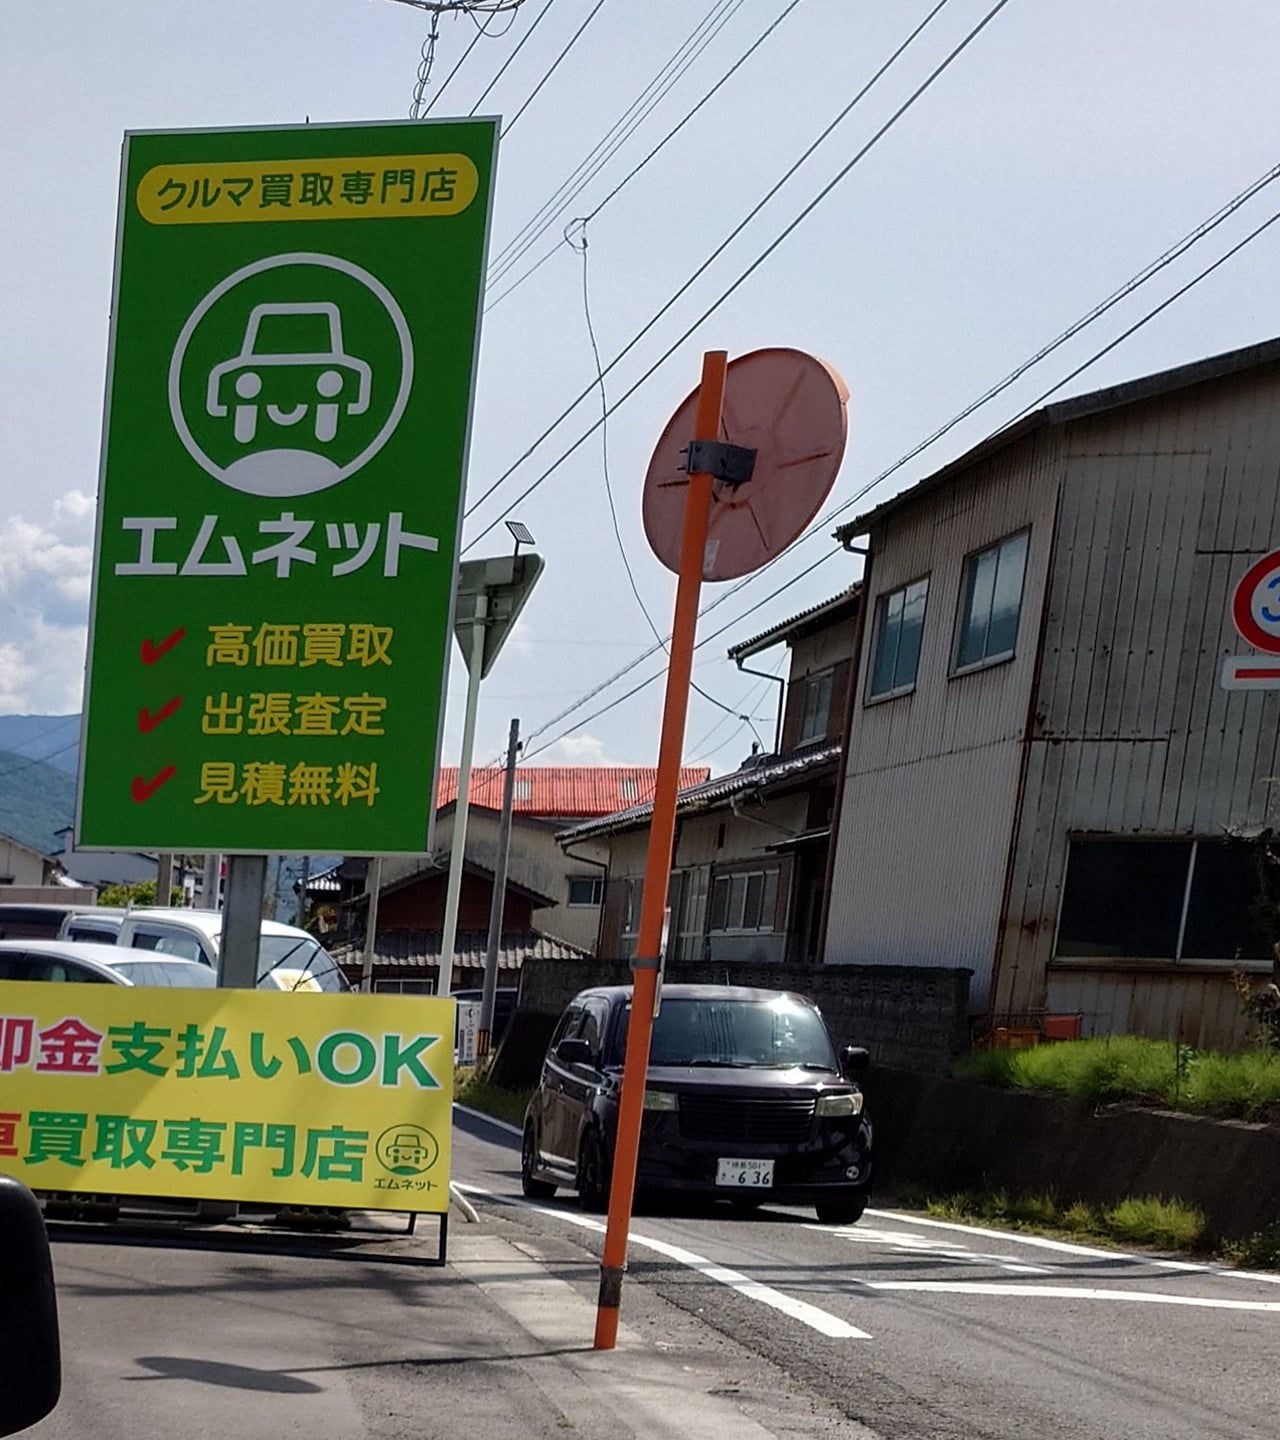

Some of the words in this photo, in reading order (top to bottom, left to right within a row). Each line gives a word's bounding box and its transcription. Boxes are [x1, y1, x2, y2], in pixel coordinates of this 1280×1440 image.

[156, 167, 459, 212] クルマ買取専門店
[114, 511, 439, 579] エムネット
[206, 622, 394, 668] 高価買取
[201, 692, 387, 737] 出張査定
[193, 761, 380, 807] 見積無料
[373, 1178, 438, 1192] エムネット
